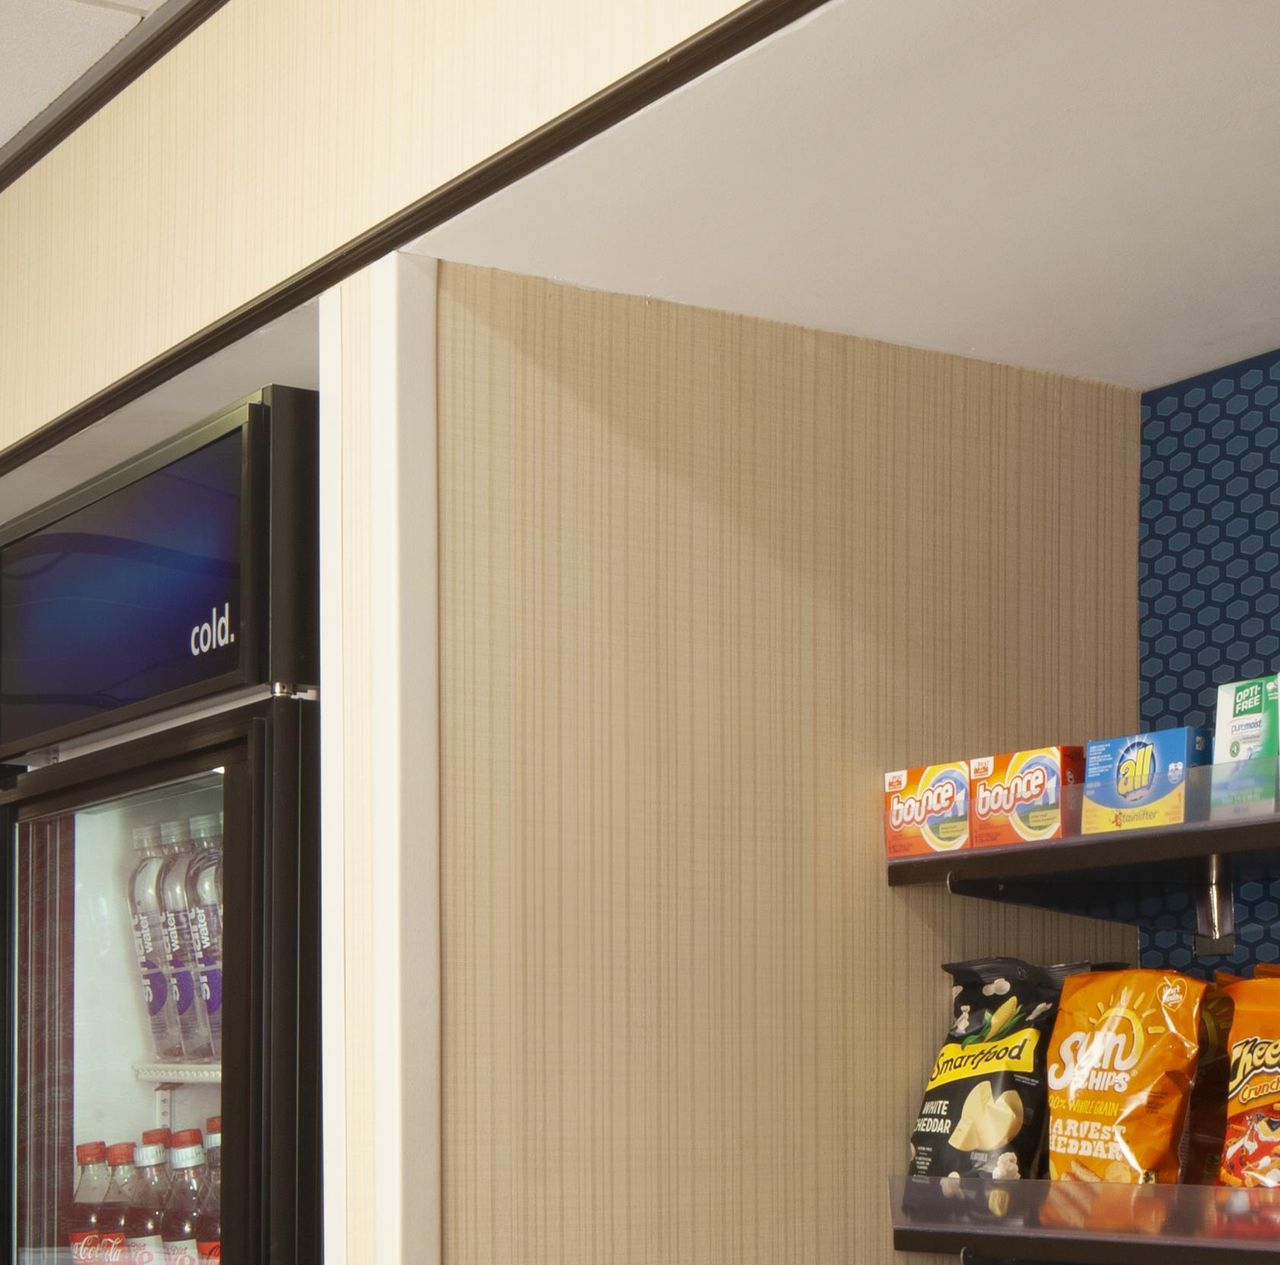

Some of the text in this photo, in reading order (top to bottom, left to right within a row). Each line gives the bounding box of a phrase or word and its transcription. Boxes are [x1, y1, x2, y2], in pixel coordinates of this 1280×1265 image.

[190, 603, 235, 657] cold.
[1234, 695, 1261, 714] FREE
[1235, 684, 1261, 703] OPTI-
[1117, 743, 1154, 796] all
[890, 780, 956, 831] bounce
[976, 767, 1047, 820] bounce
[930, 1038, 1029, 1082] Smartfood
[1048, 1030, 1144, 1091] Sun
[1078, 1070, 1132, 1093] HIPS
[922, 1100, 950, 1116] WHITE
[1049, 1115, 1126, 1141] ARVEST
